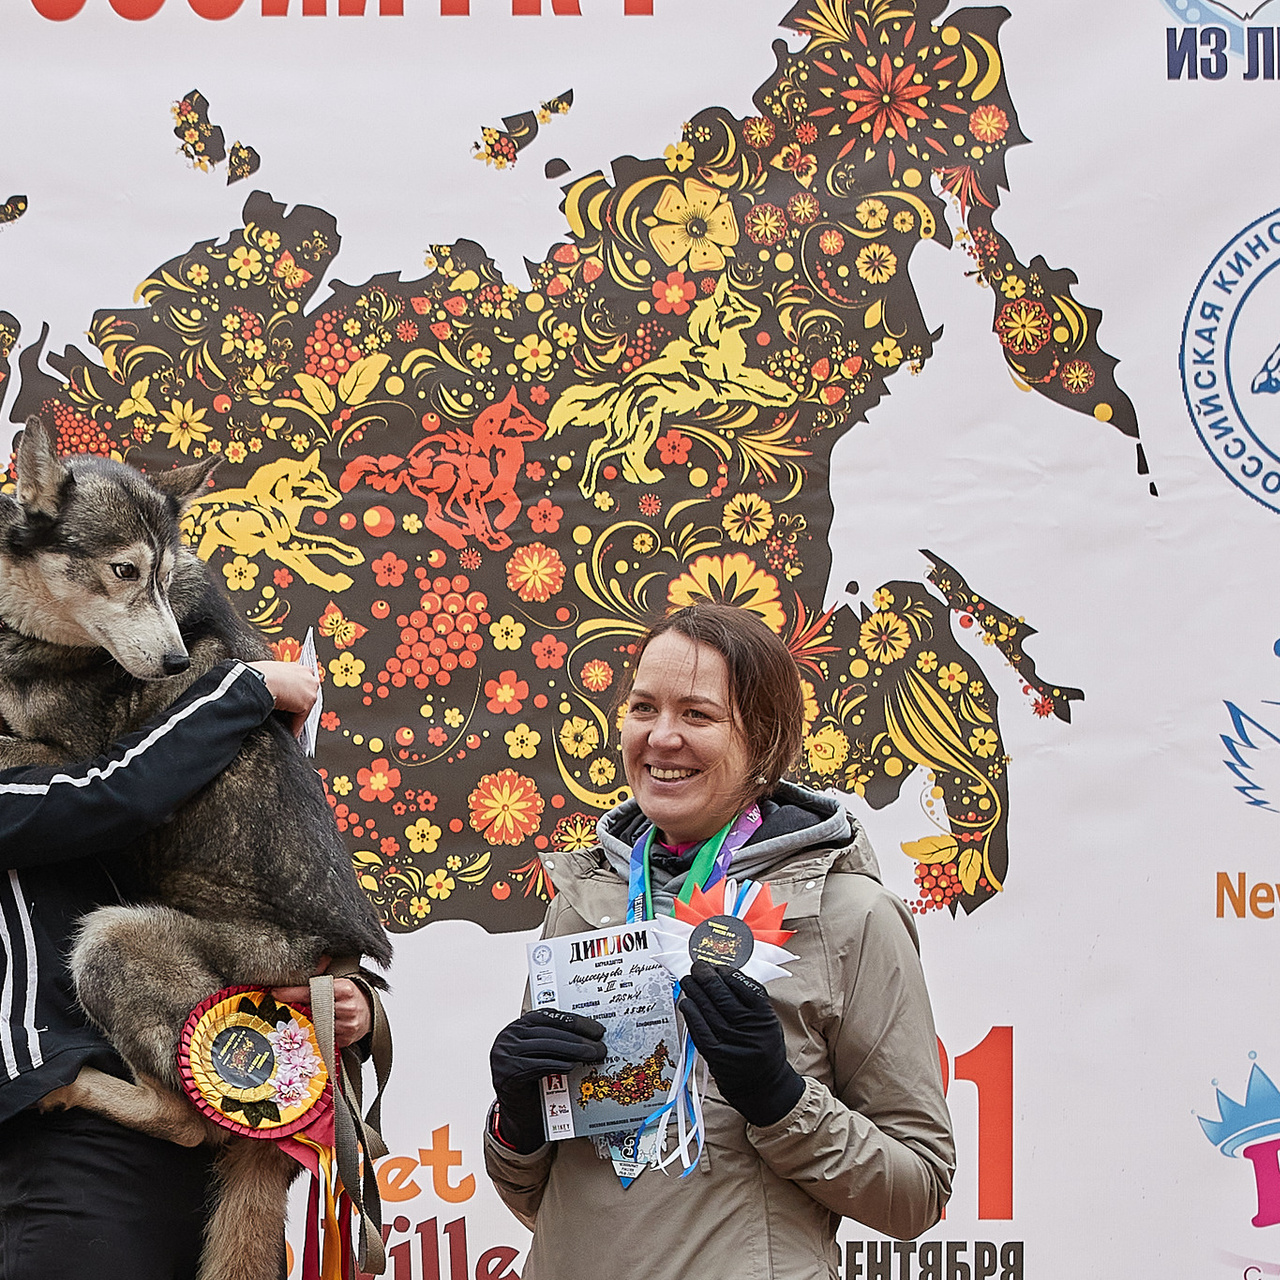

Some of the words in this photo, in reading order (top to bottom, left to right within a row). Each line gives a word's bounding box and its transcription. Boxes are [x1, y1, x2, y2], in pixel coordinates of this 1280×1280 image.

[1166, 27, 1228, 80] ИЗ
[1243, 27, 1280, 80] Л
[570, 930, 649, 964] ДИПЛОМ
[732, 972, 760, 992] CRAFT
[372, 1124, 476, 1203] et
